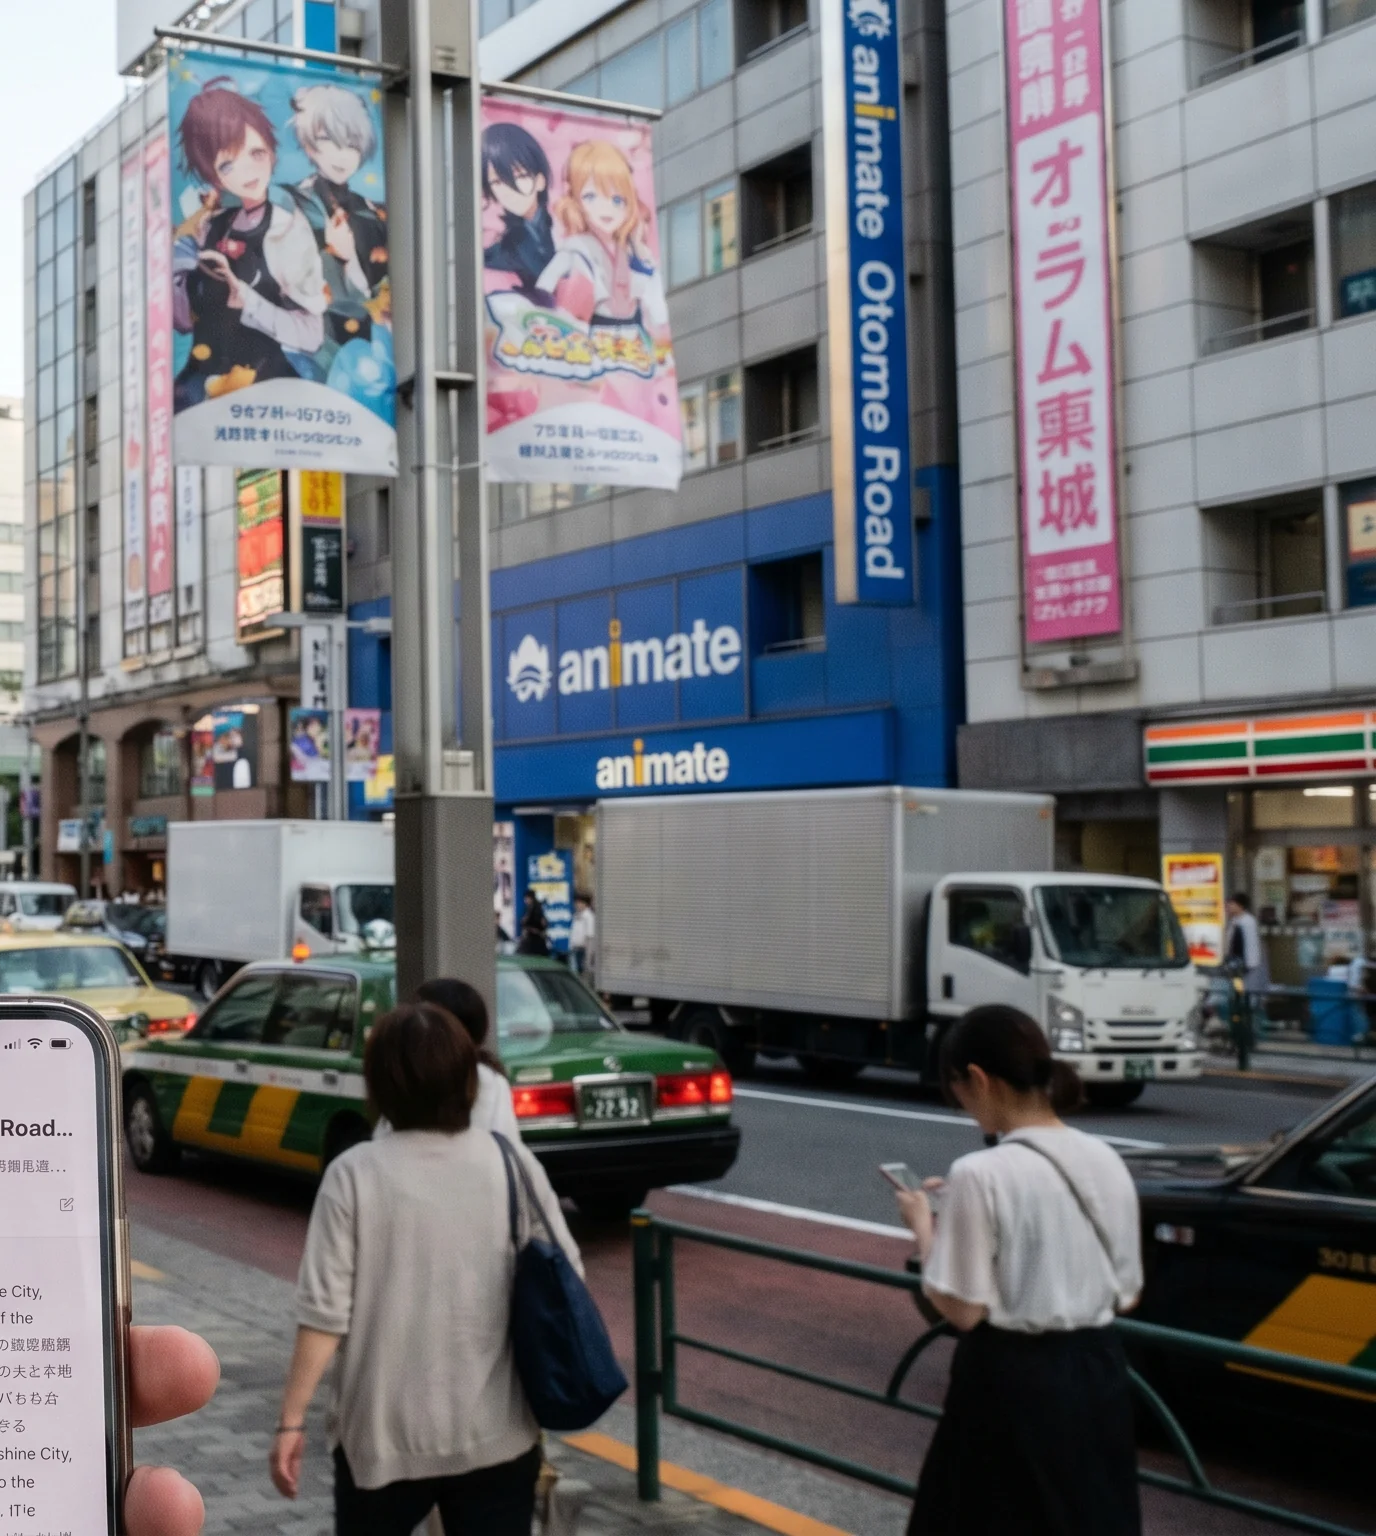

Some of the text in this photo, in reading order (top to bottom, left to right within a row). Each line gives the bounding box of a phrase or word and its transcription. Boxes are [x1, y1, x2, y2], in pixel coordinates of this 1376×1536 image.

[852, 44, 905, 579] animate Otome Road
[558, 618, 741, 696] animate
[595, 738, 730, 790] animate
[0, 1118, 73, 1137] Road...
[11, 1284, 43, 1302] City,
[9, 1311, 34, 1325] the
[40, 1446, 72, 1464] City,
[10, 1474, 35, 1489] the
